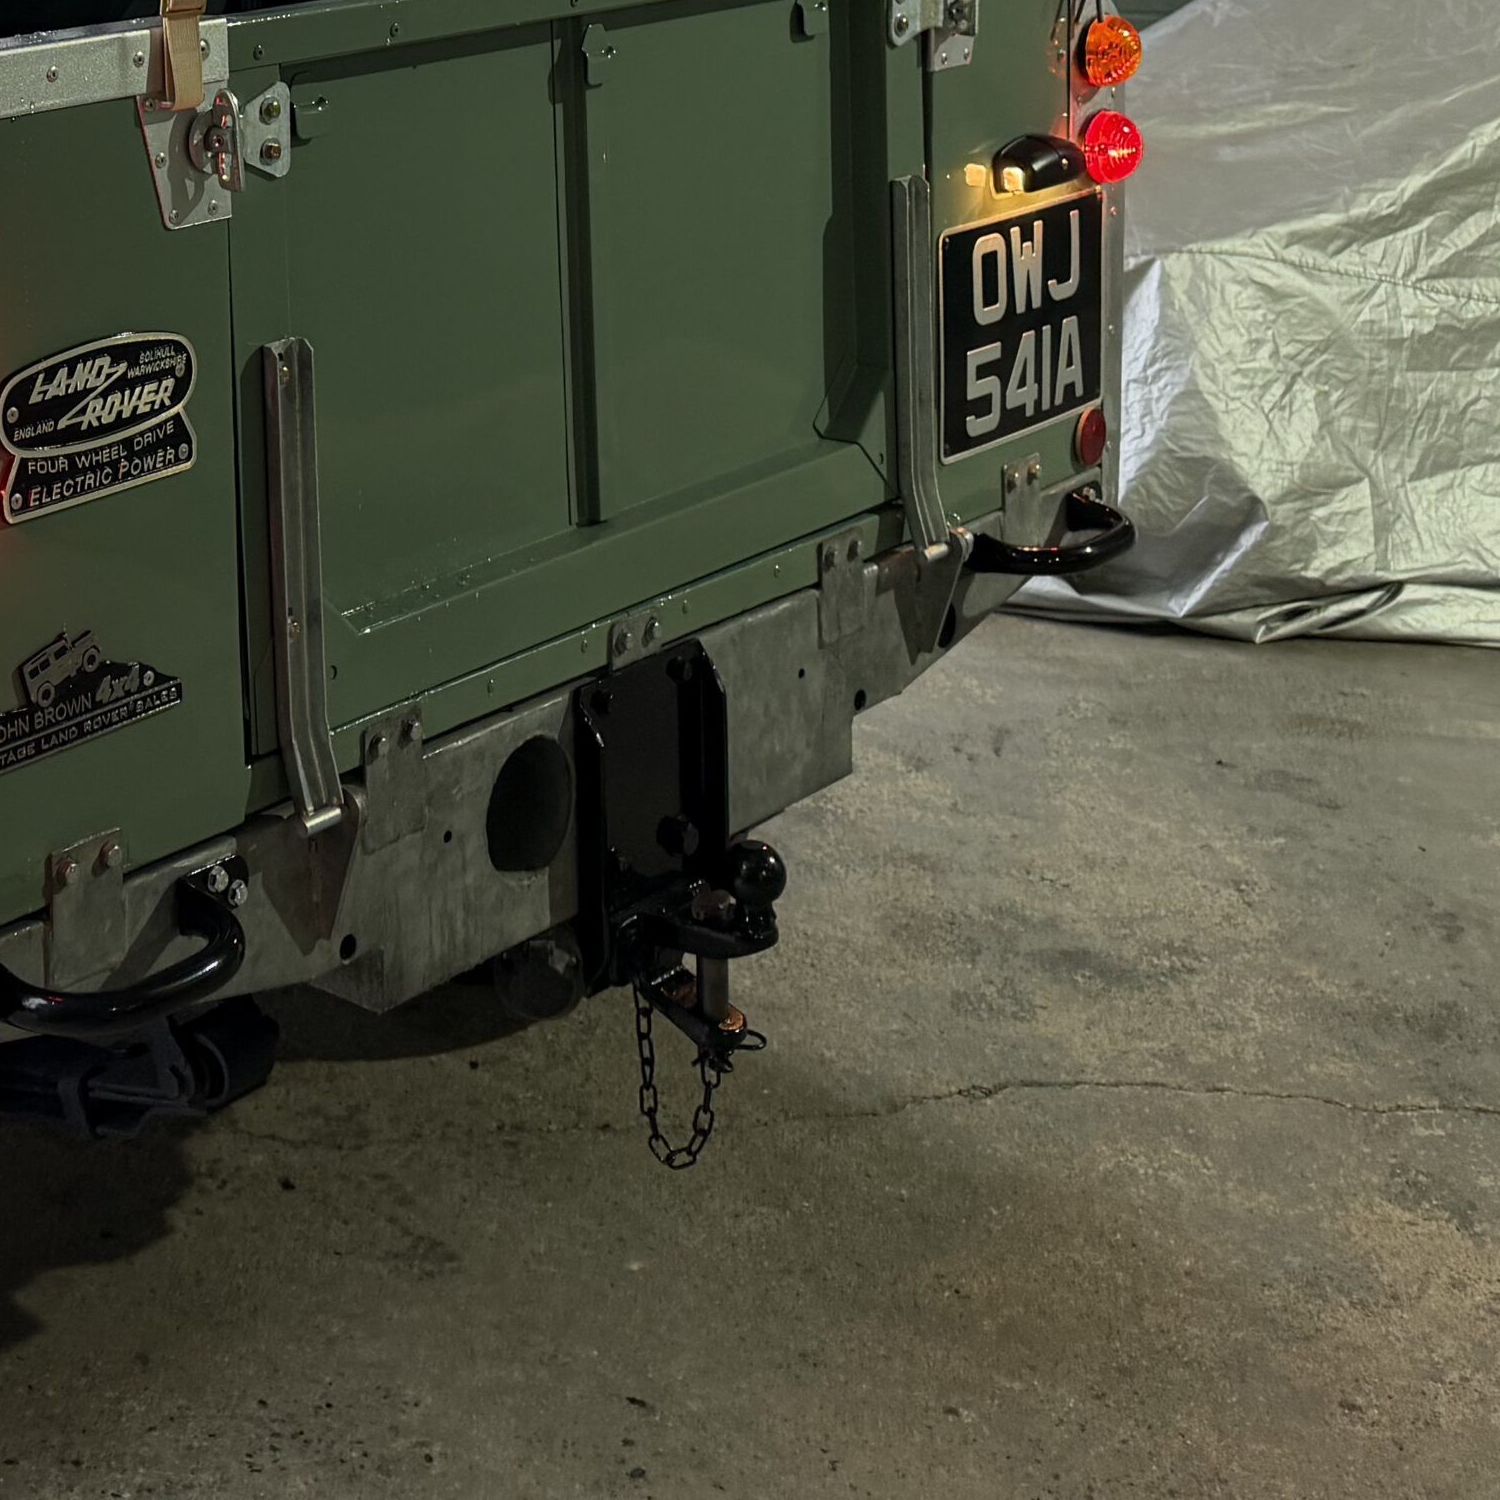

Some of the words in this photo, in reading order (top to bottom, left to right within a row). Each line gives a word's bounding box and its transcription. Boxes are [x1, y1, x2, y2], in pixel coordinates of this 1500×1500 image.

[972, 209, 1081, 326] OWJ
[29, 355, 114, 405] LAND
[127, 353, 187, 379] WARWICKSHIRE
[139, 345, 176, 364] SOLIHULL
[965, 315, 1084, 438] 541A
[80, 378, 175, 431] ROVER
[13, 421, 55, 442] ENGLAND
[28, 459, 69, 475] FOUR
[75, 445, 128, 469] WHEEL
[134, 420, 175, 451] DRIVE
[29, 468, 114, 507] ELECTRIC
[118, 449, 175, 480] POWER
[34, 692, 92, 730] BROWN
[41, 726, 79, 750] LAND
[83, 706, 129, 733] ROVER
[135, 687, 179, 714] SALES
